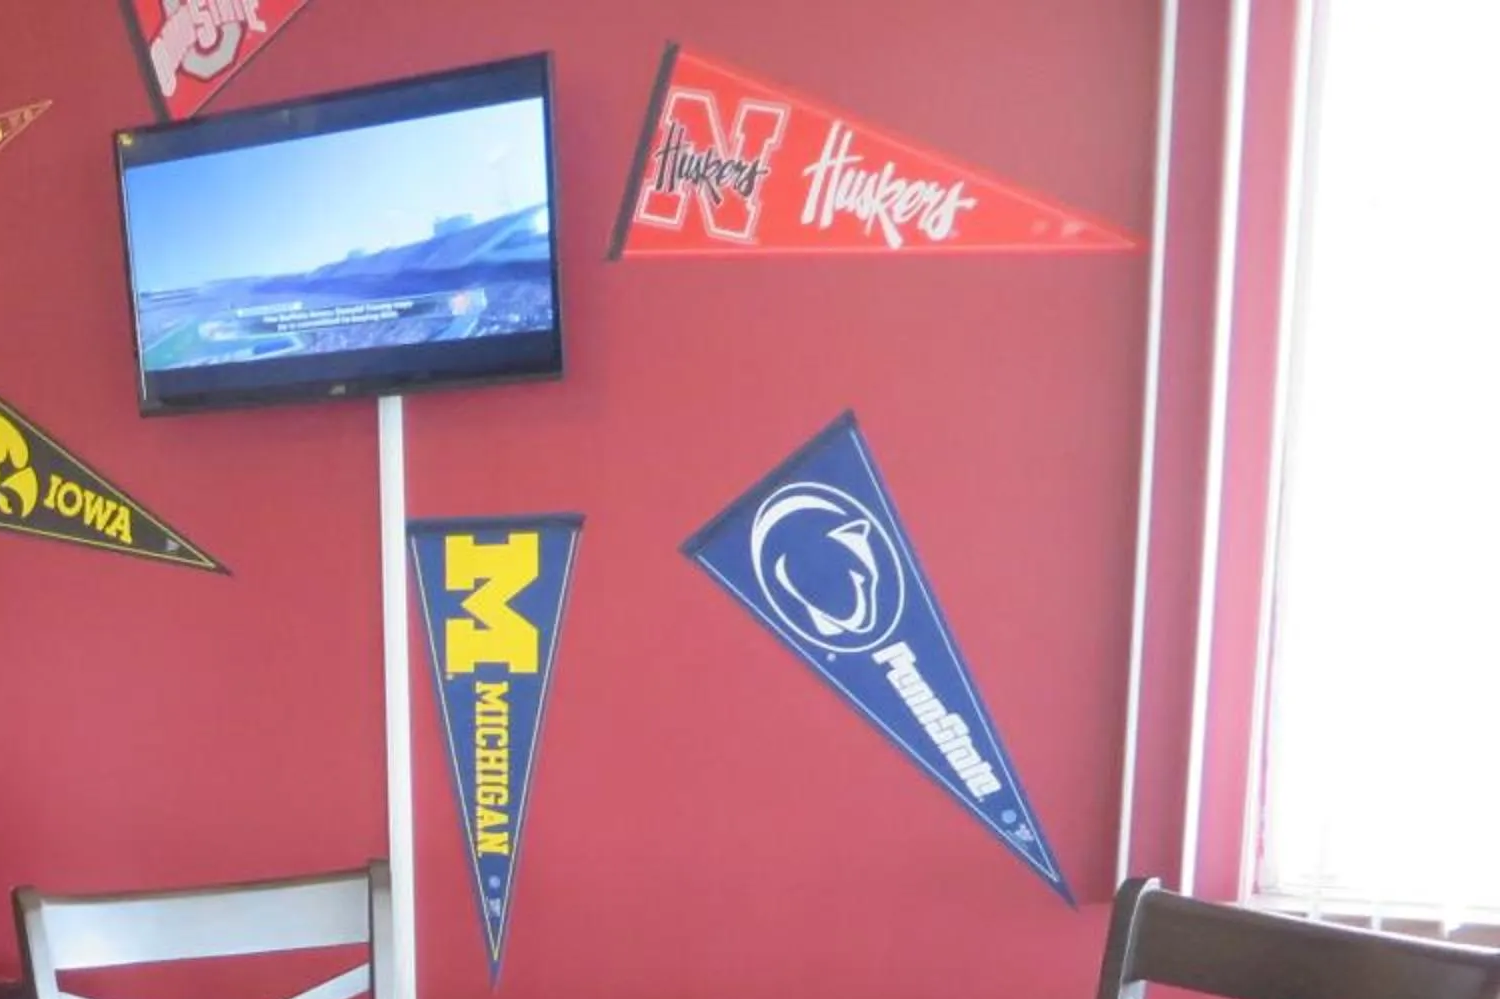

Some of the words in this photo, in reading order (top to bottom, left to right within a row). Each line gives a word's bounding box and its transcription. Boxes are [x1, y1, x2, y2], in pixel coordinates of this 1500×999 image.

[654, 123, 769, 205] Huskers
[800, 119, 978, 249] Huskers
[42, 474, 134, 545] IOWA
[445, 532, 540, 674] M
[474, 681, 510, 858] MICHIGAN
